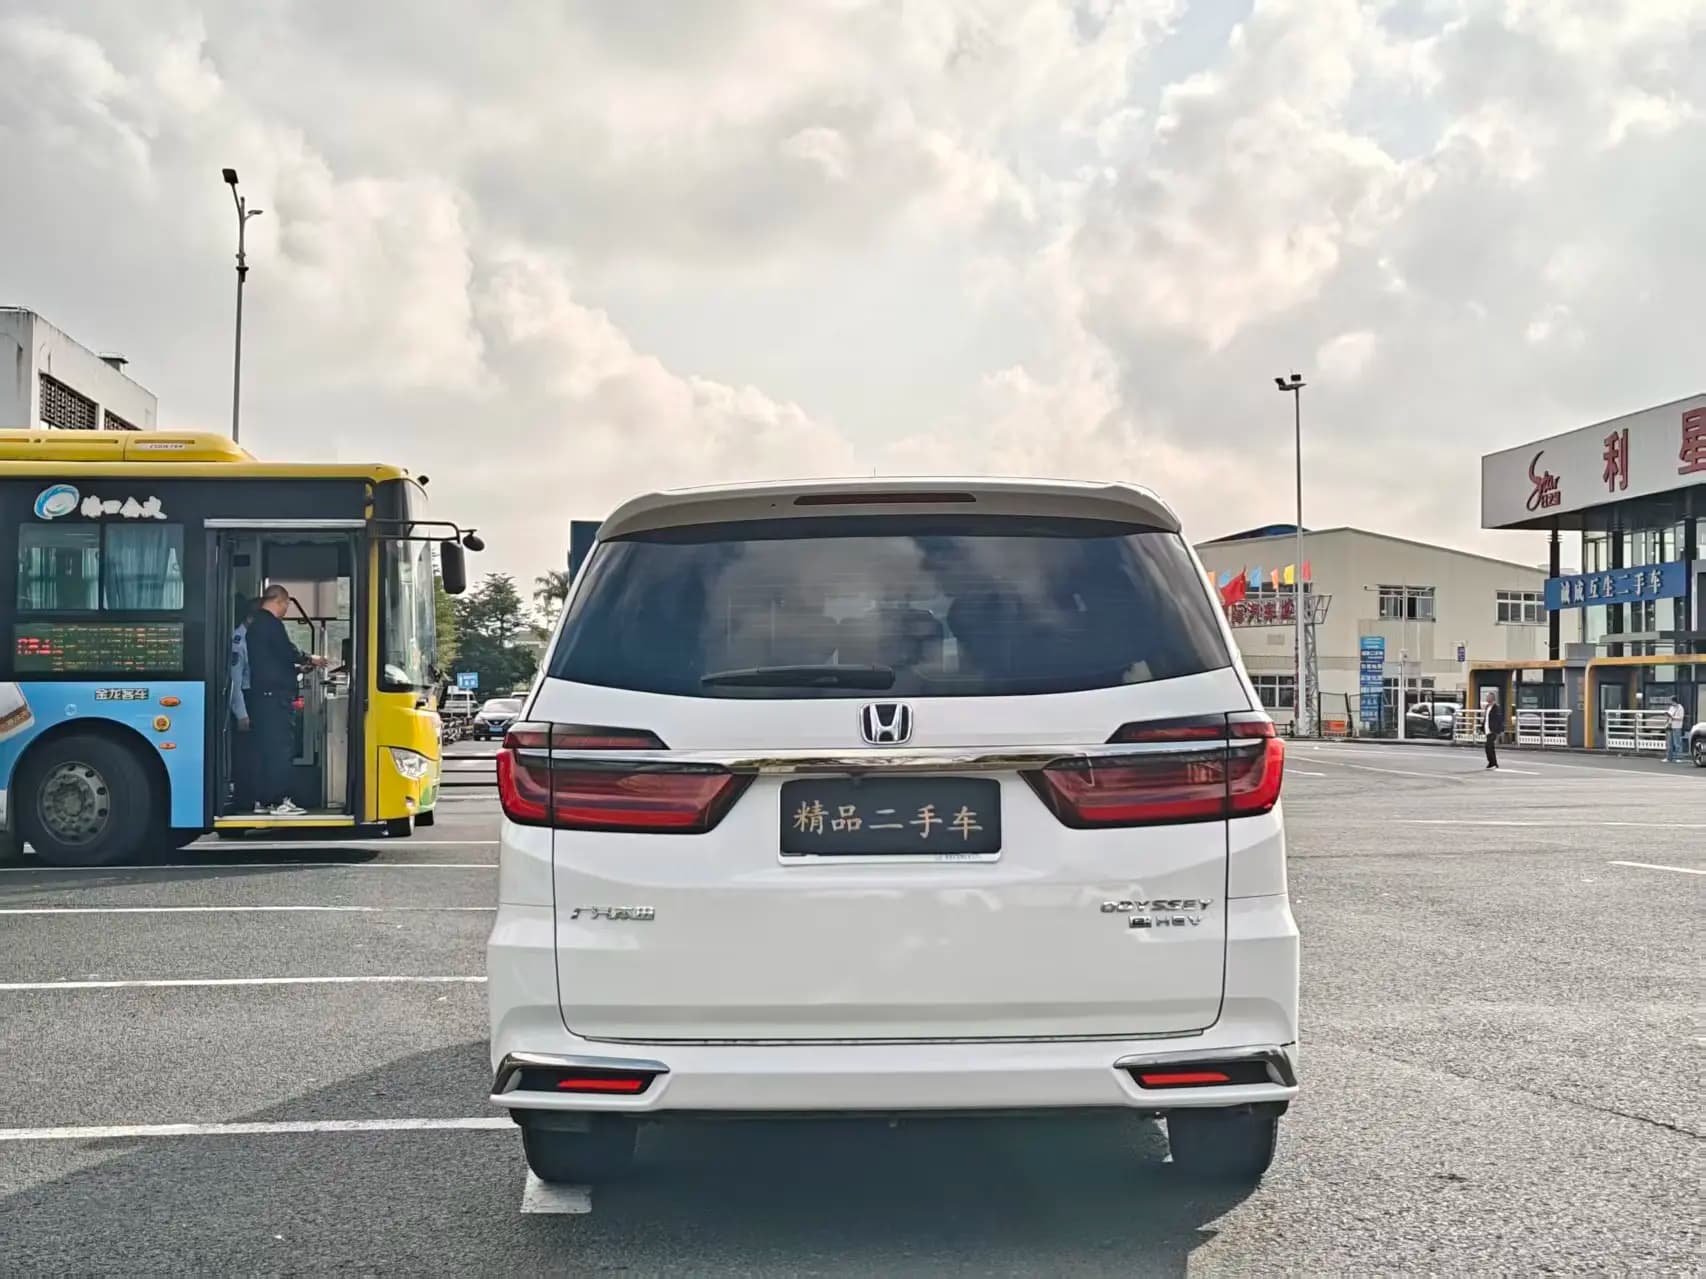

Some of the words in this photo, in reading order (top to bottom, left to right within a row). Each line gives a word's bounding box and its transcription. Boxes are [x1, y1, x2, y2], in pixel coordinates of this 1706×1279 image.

[1603, 406, 1706, 493] 利星
[95, 688, 148, 700] 金龙客车
[792, 800, 984, 841] 精品二手车
[1100, 899, 1213, 913] ODYSSEY
